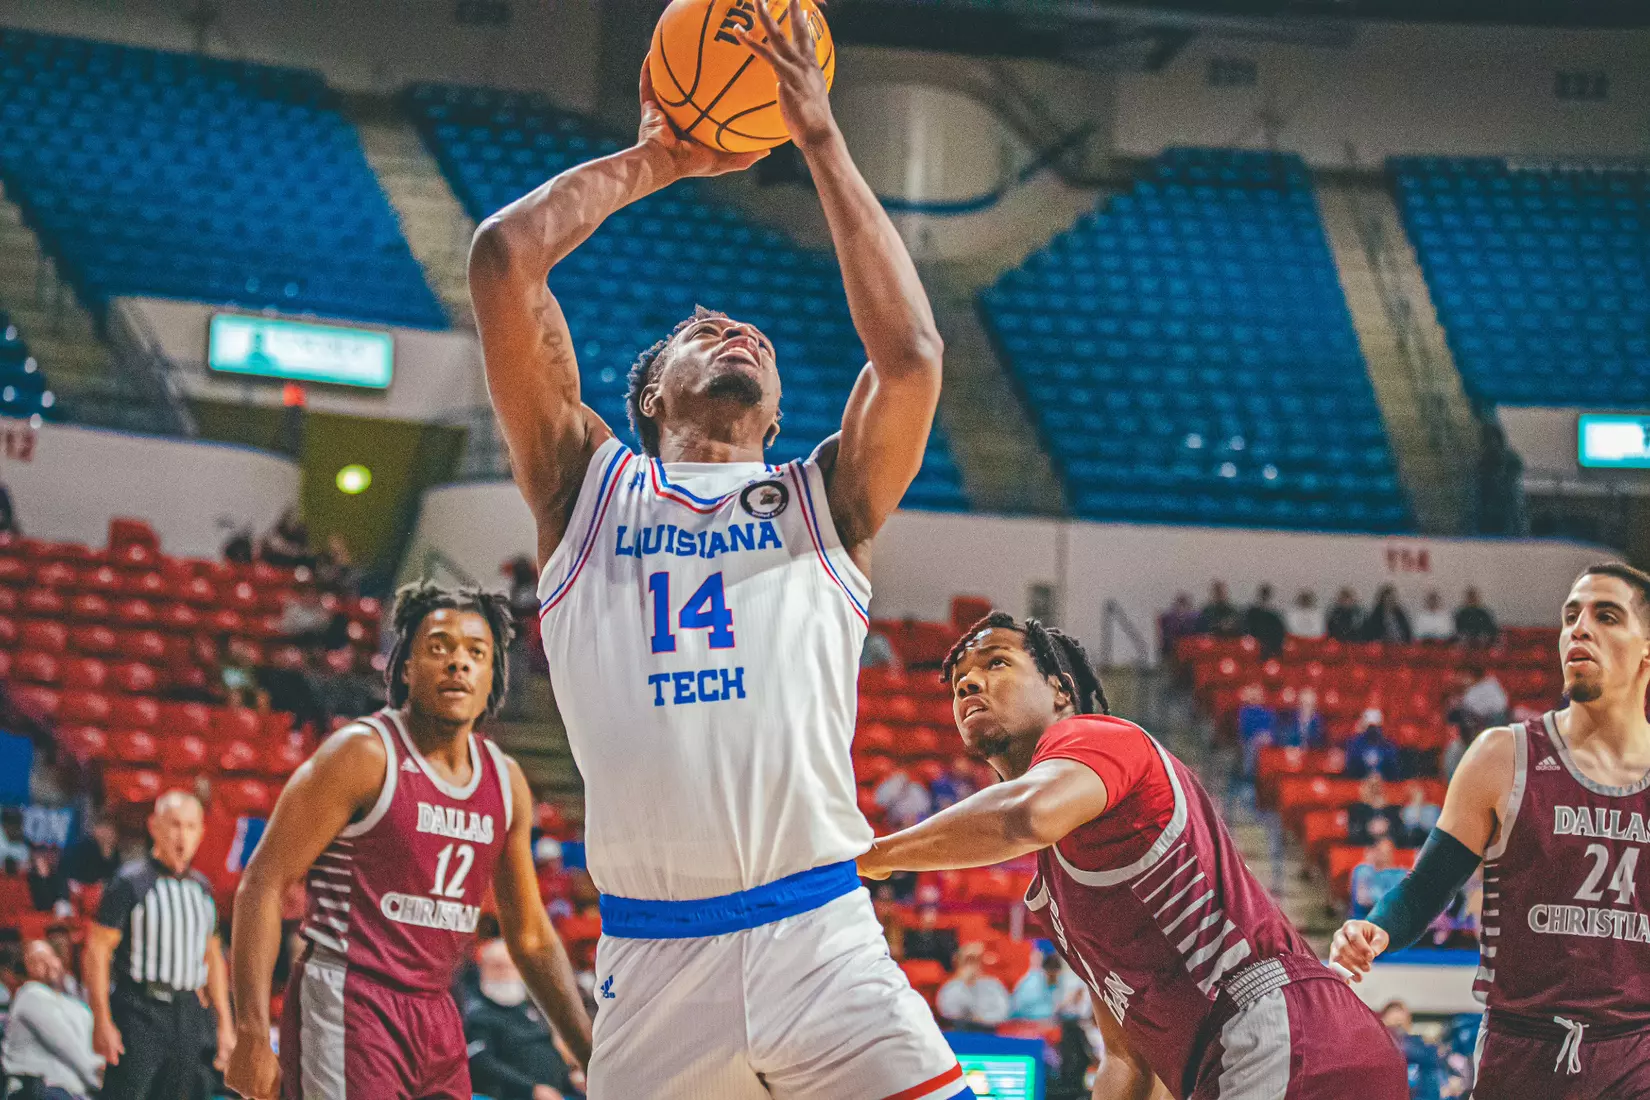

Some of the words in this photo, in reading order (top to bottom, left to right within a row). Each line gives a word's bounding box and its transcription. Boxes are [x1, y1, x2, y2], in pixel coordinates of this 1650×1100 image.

[648, 571, 735, 655] 14
[648, 666, 746, 707] TECH
[416, 802, 494, 844] DALLAS
[1553, 805, 1650, 843] DALLA
[429, 843, 475, 898] 12
[1573, 843, 1641, 905] 24
[1527, 903, 1650, 944] CHRISTIA
